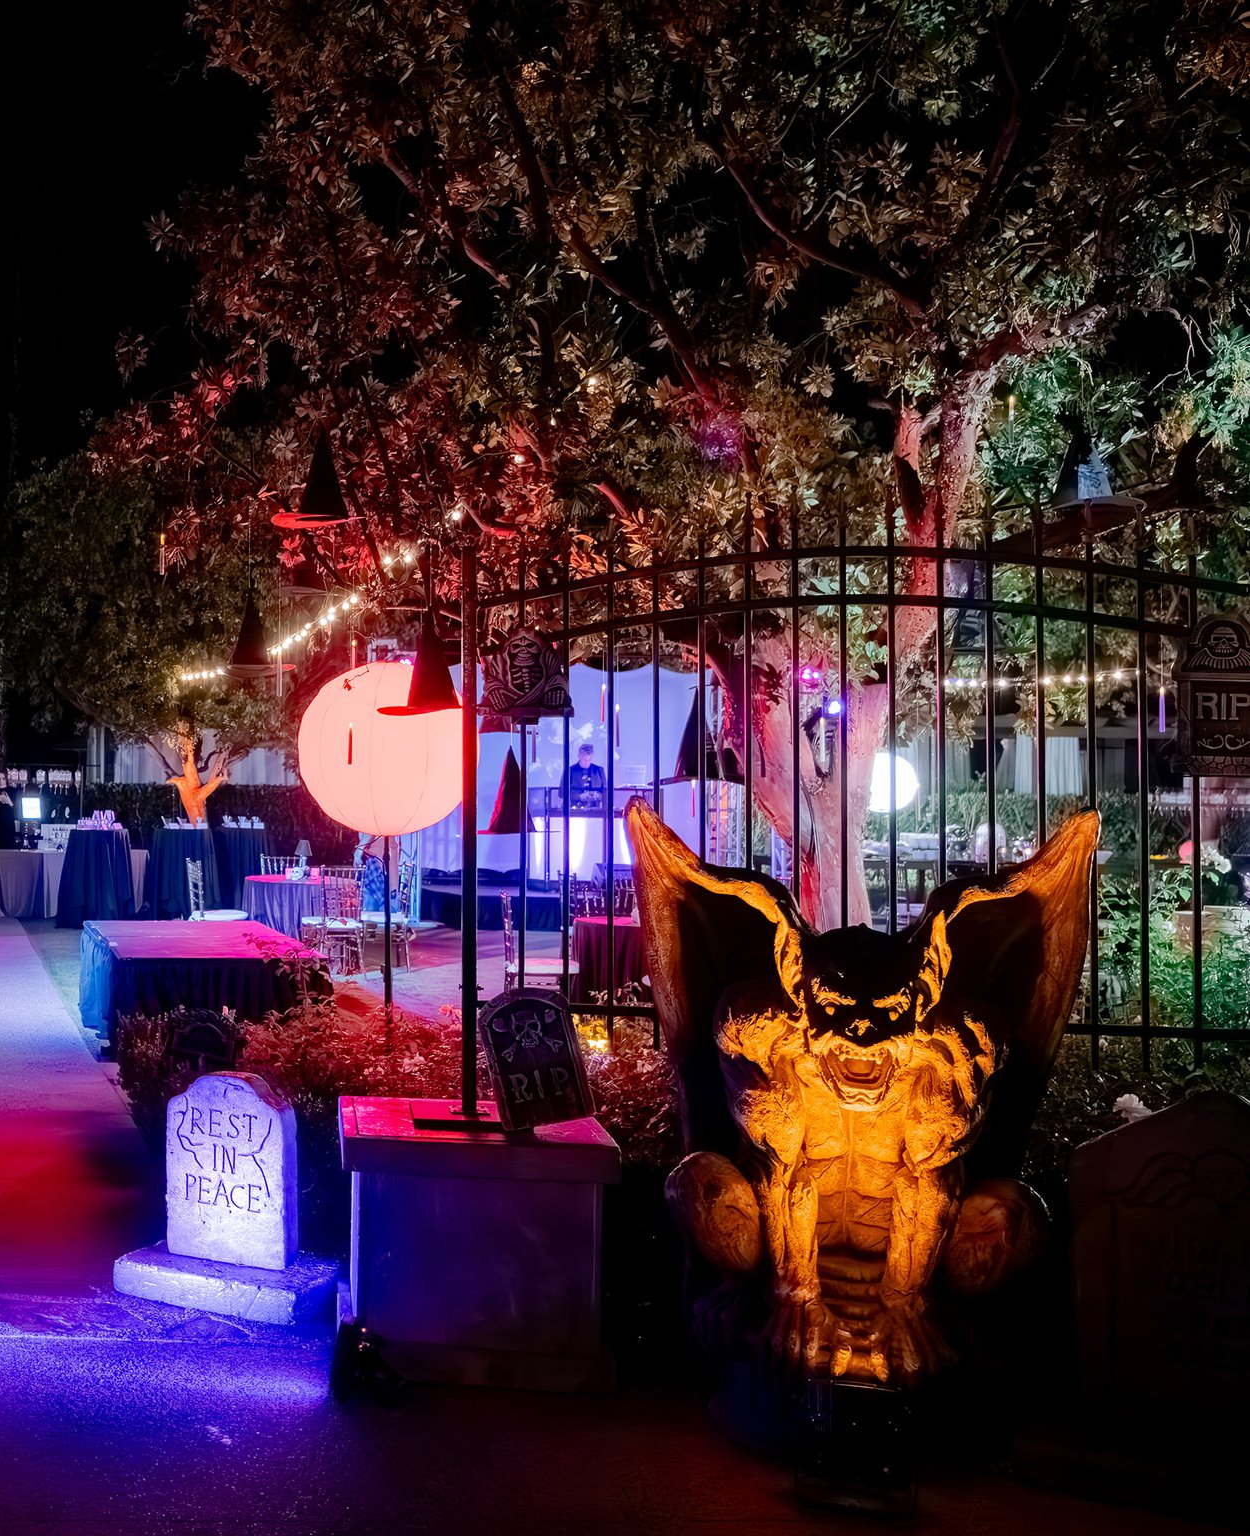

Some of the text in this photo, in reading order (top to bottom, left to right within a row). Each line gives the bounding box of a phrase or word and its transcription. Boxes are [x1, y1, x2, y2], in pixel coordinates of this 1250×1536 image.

[1195, 692, 1250, 720] RIP
[508, 1067, 569, 1103] RIP
[190, 1106, 258, 1142] REST
[212, 1143, 236, 1174] IN
[185, 1172, 262, 1214] PEACE
